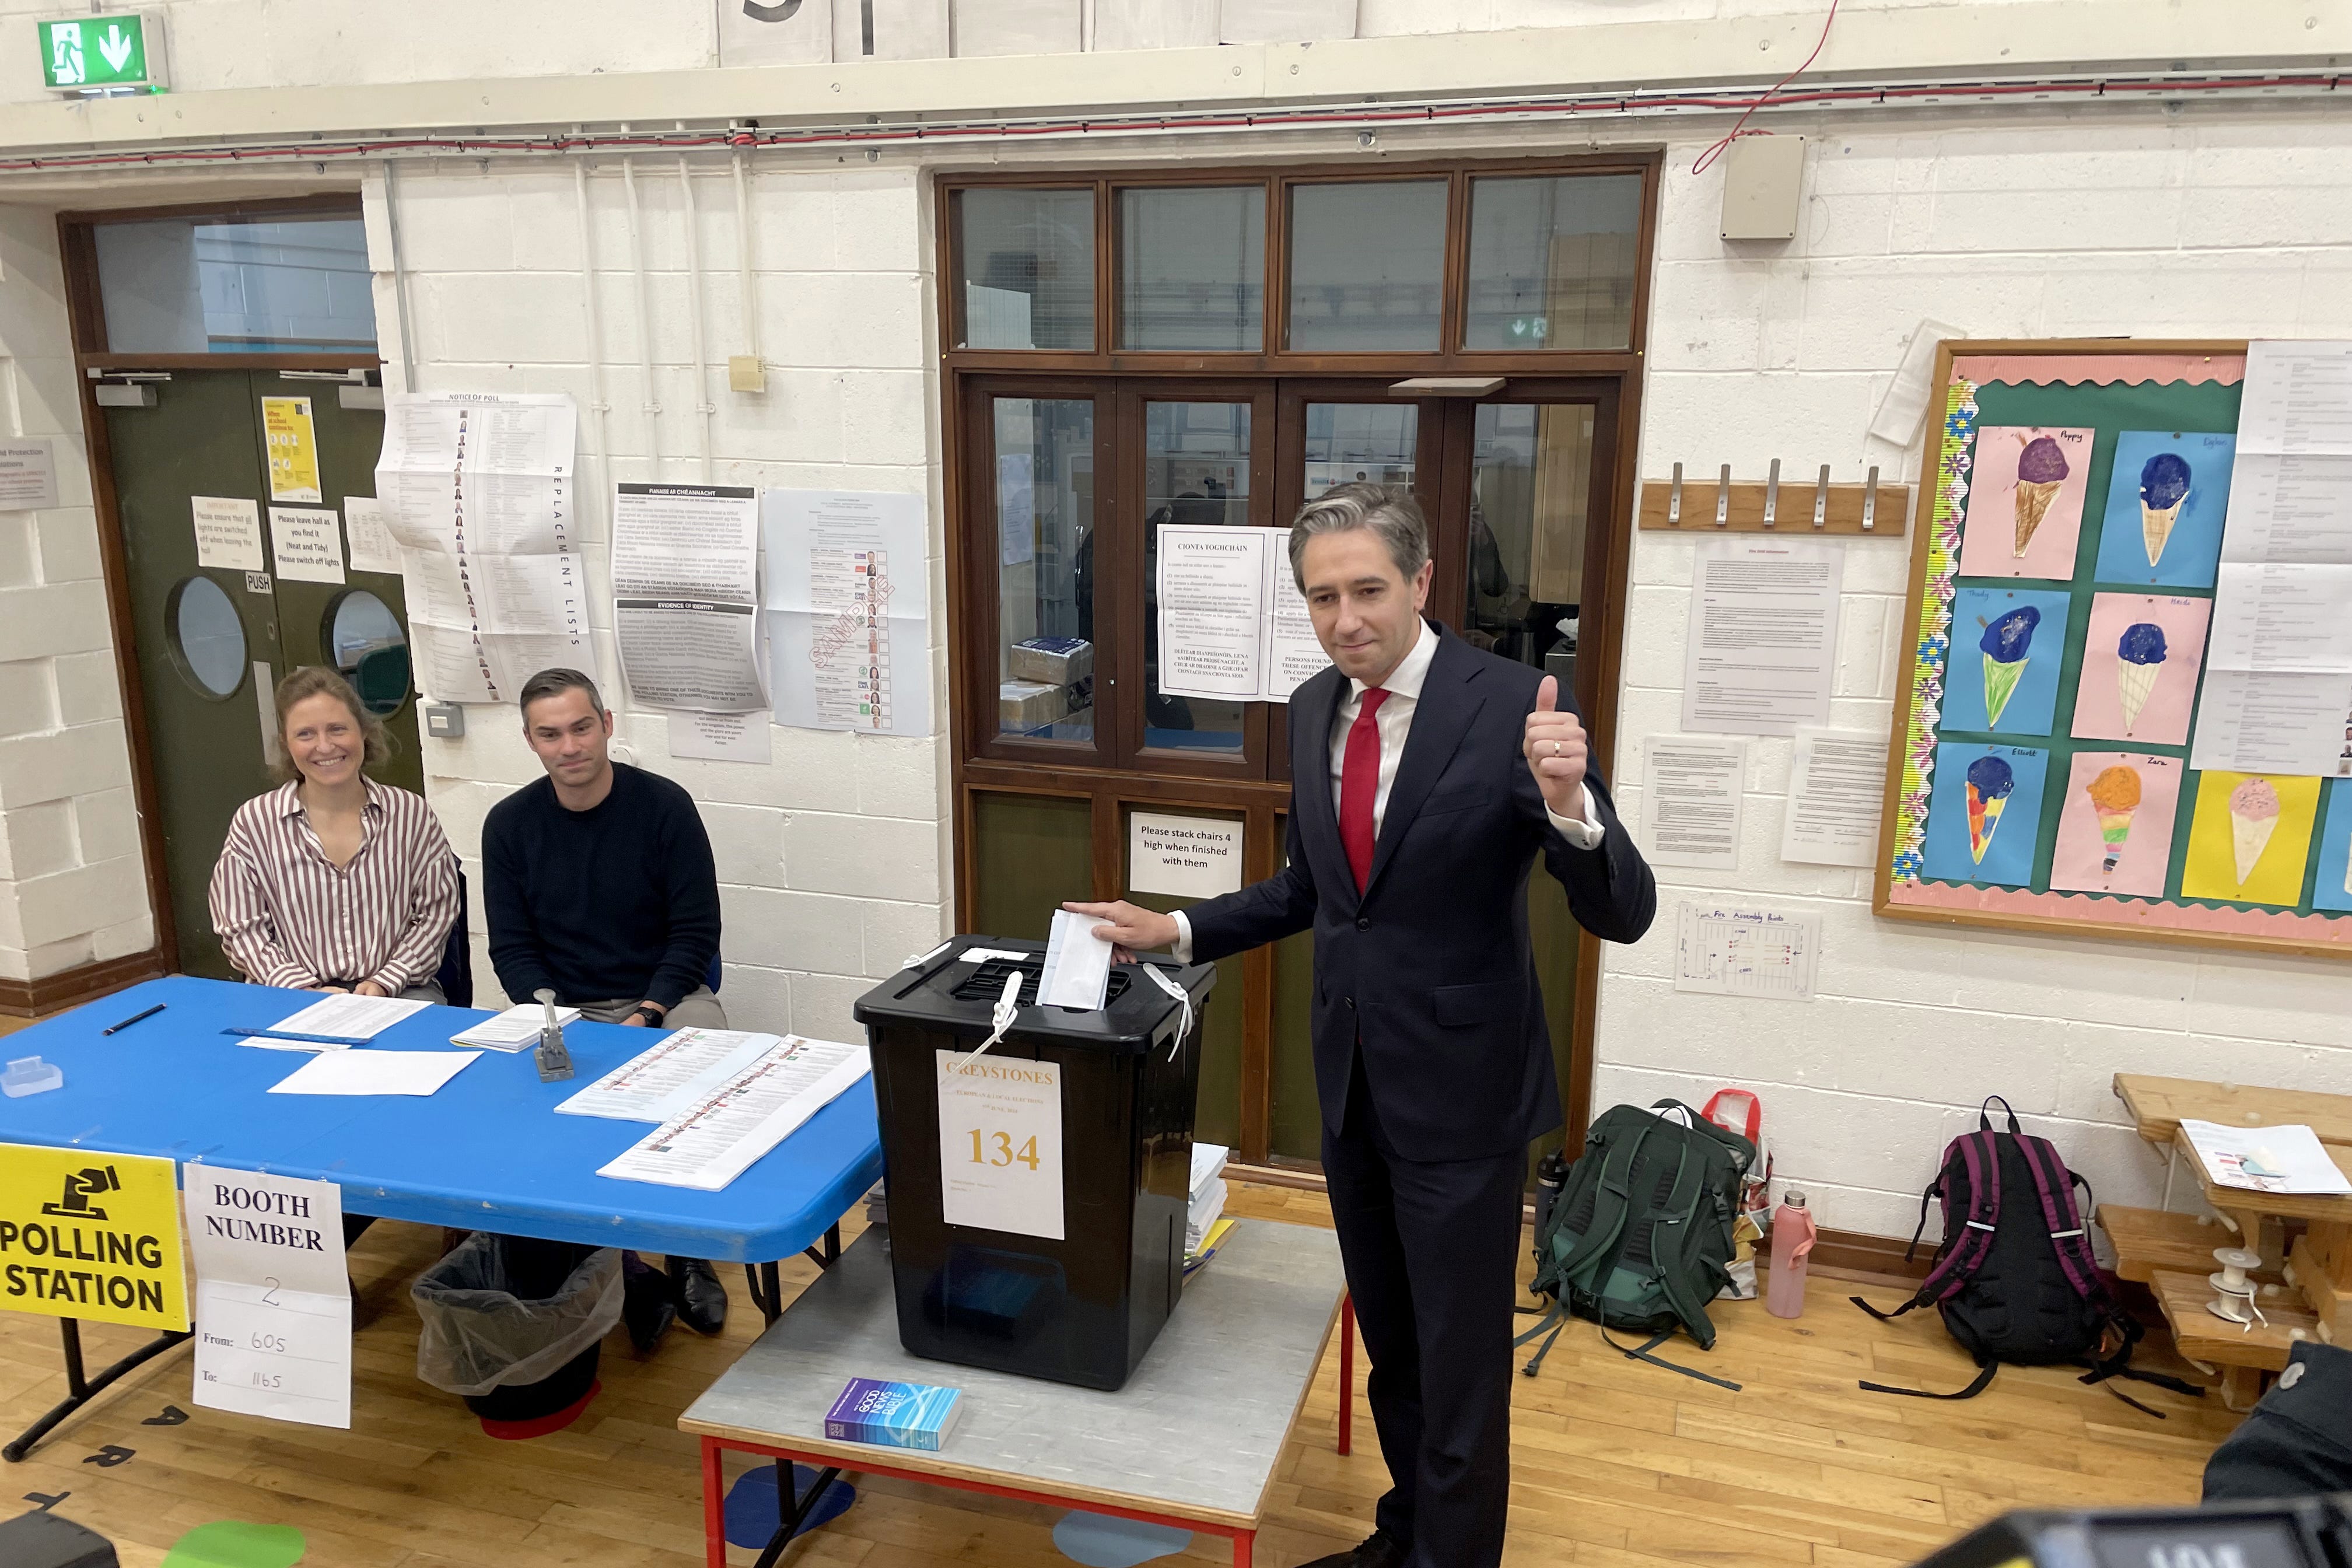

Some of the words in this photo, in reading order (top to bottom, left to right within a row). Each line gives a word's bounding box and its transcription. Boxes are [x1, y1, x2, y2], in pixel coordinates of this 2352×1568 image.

[2061, 430, 2082, 443] Poppy
[196, 512, 213, 520] Please
[278, 515, 295, 523] Please
[296, 516, 311, 524] leave
[198, 523, 213, 533] lights
[303, 528, 314, 537] find
[224, 537, 242, 547] leaving
[286, 541, 301, 551] (Neat
[314, 544, 328, 554] Tidy)
[1205, 543, 1248, 551] TOGHCHÁIN
[278, 555, 295, 563] Please
[296, 556, 314, 565] switch
[324, 558, 340, 567] lights
[554, 466, 572, 586] REPLACEMENT
[565, 599, 579, 645] LISTS
[247, 575, 270, 590] PUSH
[808, 575, 895, 668] SAMPLE
[2012, 748, 2038, 757] Elliott
[2147, 757, 2167, 766] Zara
[1141, 825, 1170, 836] Please
[1171, 830, 1194, 838] stack
[1196, 831, 1223, 841] chairs
[1225, 834, 1231, 842] 4
[1144, 840, 1163, 850] high
[1165, 842, 1189, 852] when
[1192, 845, 1227, 856] finished
[1162, 856, 1182, 866] with
[1184, 858, 1208, 868] them
[1733, 911, 1763, 923] Assembly
[946, 1061, 1053, 1085] GREYSTONES
[967, 1128, 1040, 1171] 134
[214, 1184, 312, 1219] BOOTH
[205, 1215, 325, 1251] NUMBER
[0, 1221, 163, 1269] POLLING
[6, 1264, 164, 1313] STATION
[262, 1276, 281, 1306] 2
[204, 1332, 234, 1347] From:
[251, 1331, 286, 1352] 605
[202, 1370, 217, 1382] To:
[253, 1372, 282, 1388] 1165
[859, 1390, 880, 1412] GOOD
[870, 1391, 892, 1414] NEWS
[881, 1392, 907, 1416] BIBLE
